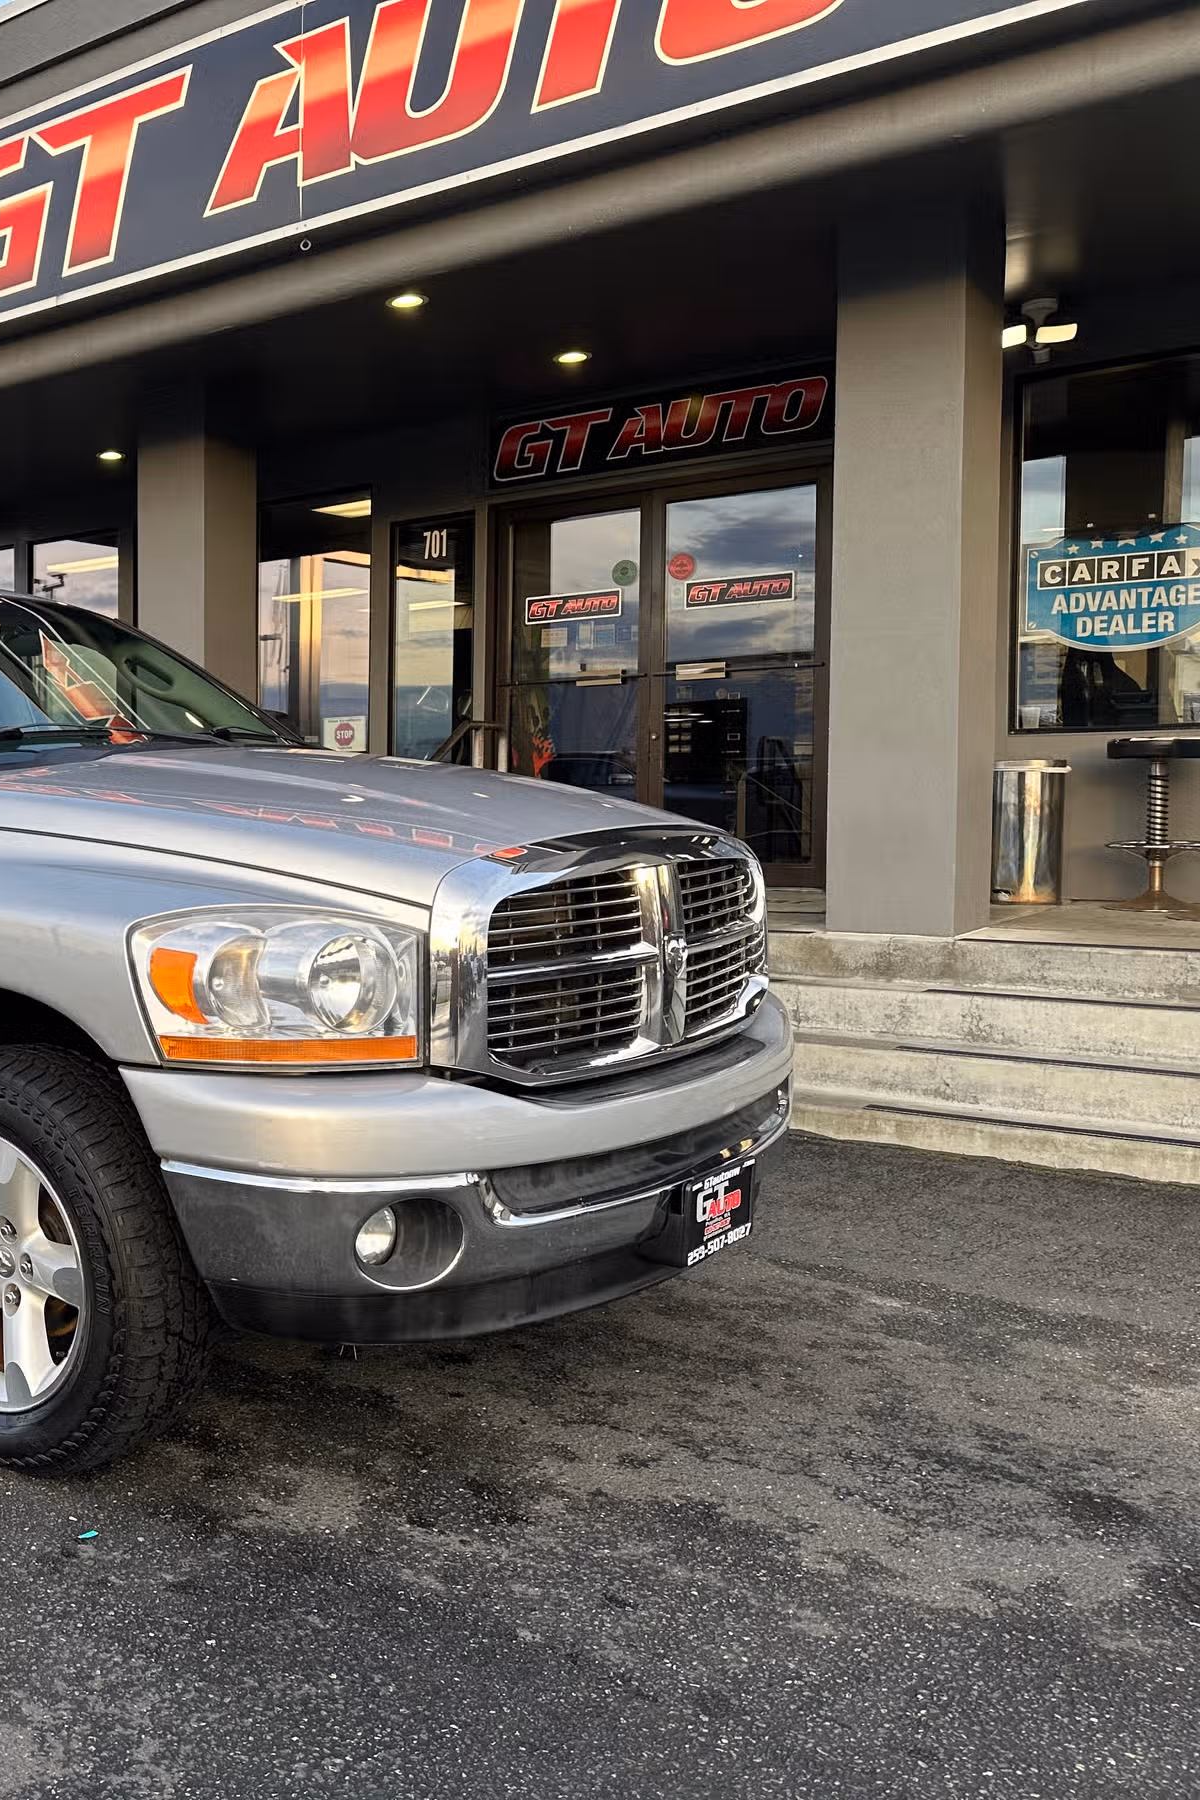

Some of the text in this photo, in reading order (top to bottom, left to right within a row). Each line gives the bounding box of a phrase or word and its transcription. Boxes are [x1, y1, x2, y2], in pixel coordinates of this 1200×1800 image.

[493, 375, 829, 483] GT AUTO
[423, 528, 448, 560] 701
[688, 577, 791, 604] GT AUTO
[1051, 584, 1200, 615] ADVANTAGE
[528, 594, 619, 619] GT AUTO
[1076, 611, 1175, 638] DEALER
[336, 729, 354, 739] STOP
[707, 1189, 742, 1220] AUTO
[67, 1185, 111, 1314] TERRAIN
